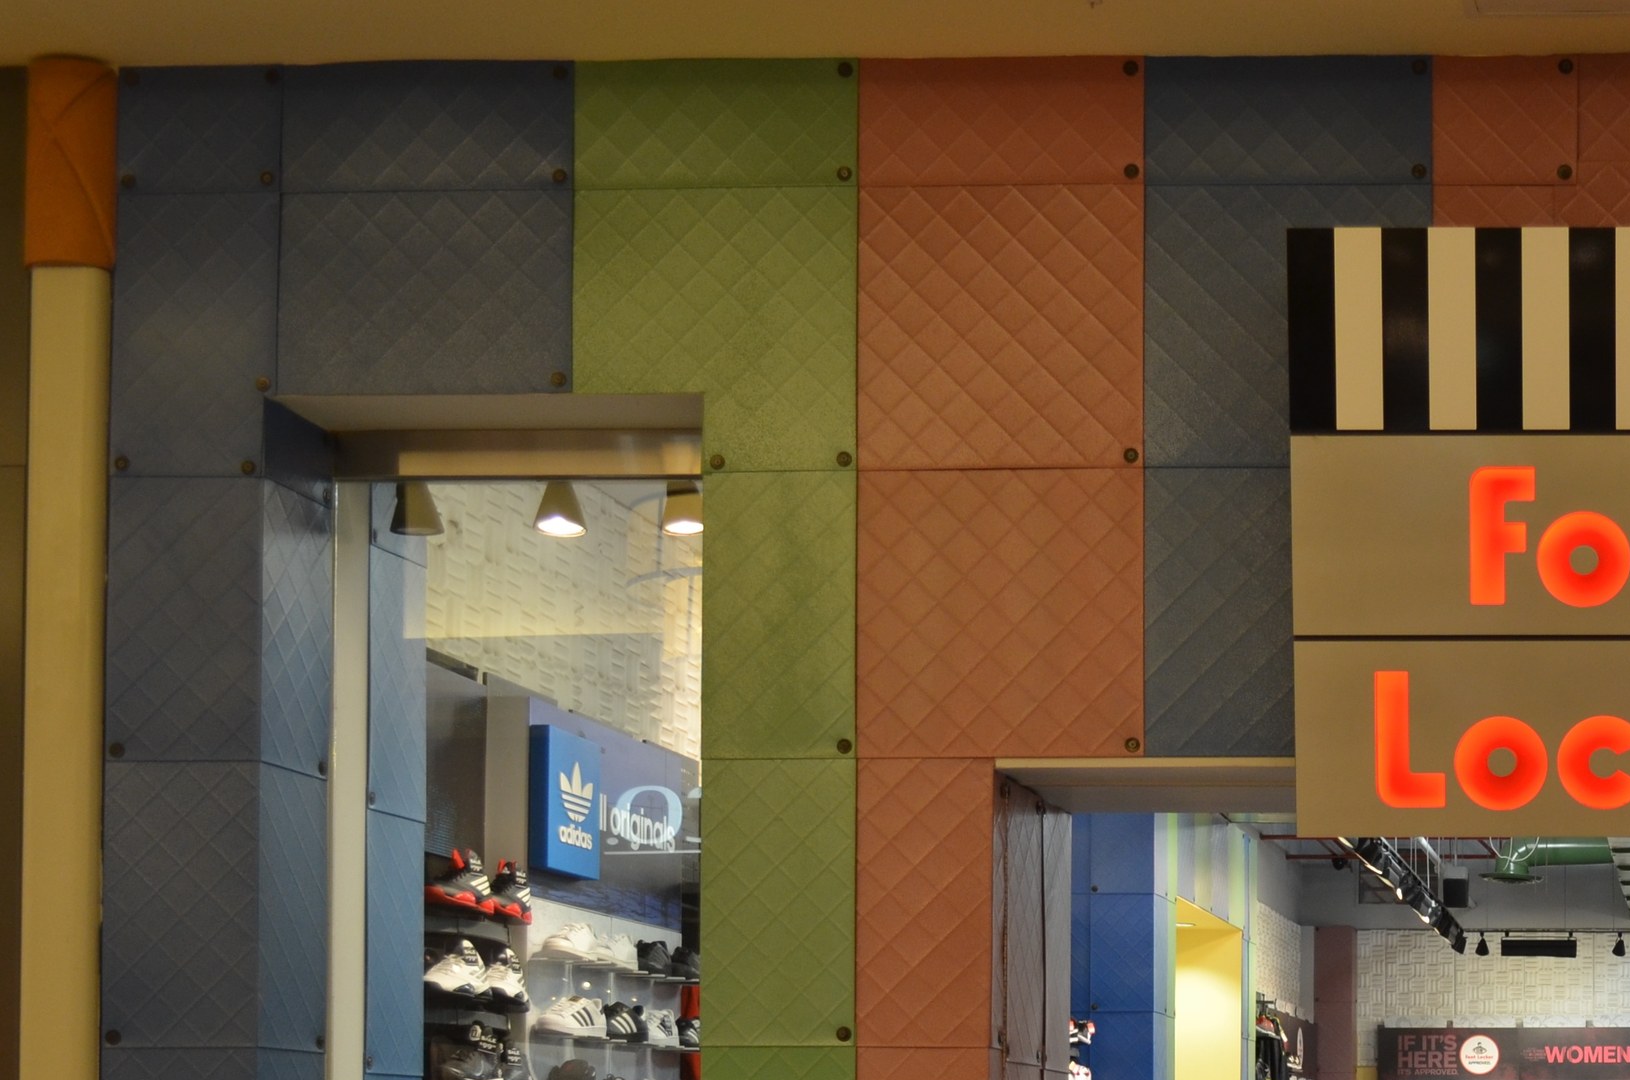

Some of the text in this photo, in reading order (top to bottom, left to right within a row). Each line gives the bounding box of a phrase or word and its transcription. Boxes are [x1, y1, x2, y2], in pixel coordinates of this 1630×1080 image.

[558, 825, 593, 850] adidas
[610, 803, 676, 853] originals
[1397, 1034, 1458, 1051] IF IT'S
[1397, 1051, 1458, 1068] HERE
